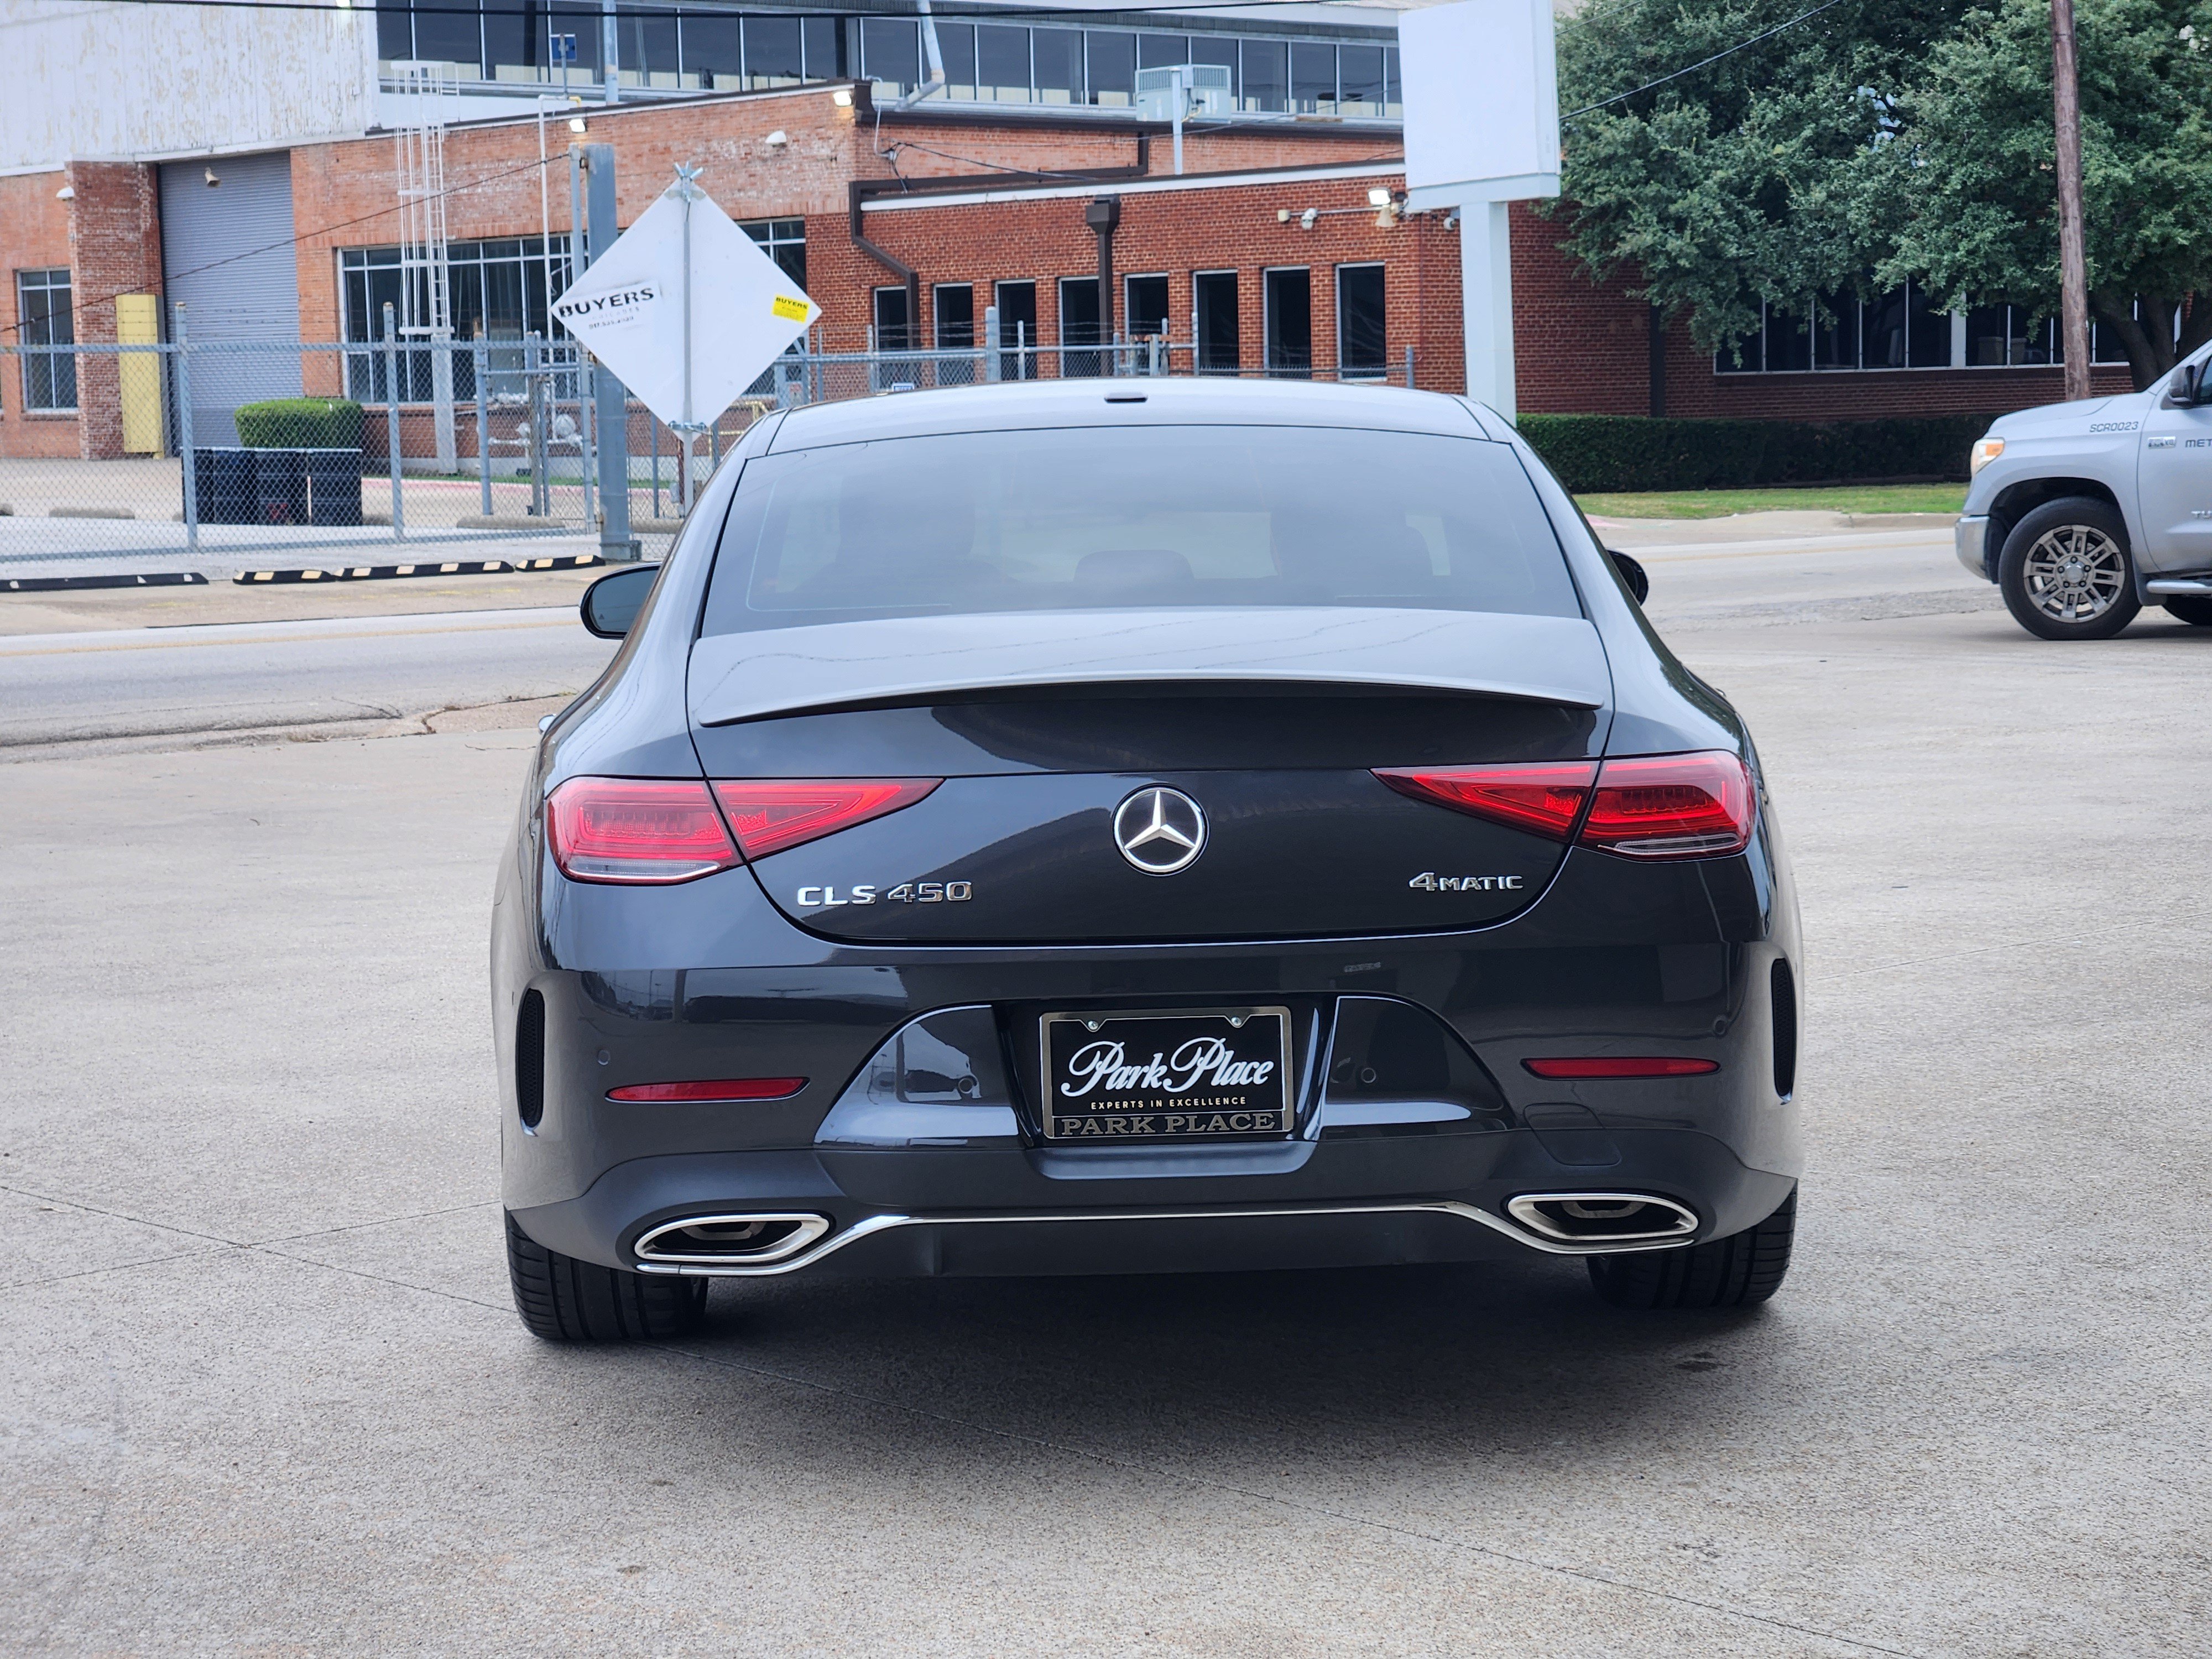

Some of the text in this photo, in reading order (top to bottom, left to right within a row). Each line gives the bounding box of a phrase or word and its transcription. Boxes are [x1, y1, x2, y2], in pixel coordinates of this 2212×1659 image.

[559, 288, 654, 318] BUYERS
[776, 297, 807, 310] BUYERS
[2090, 421, 2138, 432] SCR0023
[1408, 872, 1524, 891] 4MATIC
[797, 881, 973, 906] CLS 450
[1061, 1037, 1274, 1098] Park Place
[1091, 1097, 1246, 1110] EXPERTS IN EXCELLENCE
[1061, 1112, 1276, 1136] PARK PLACE
